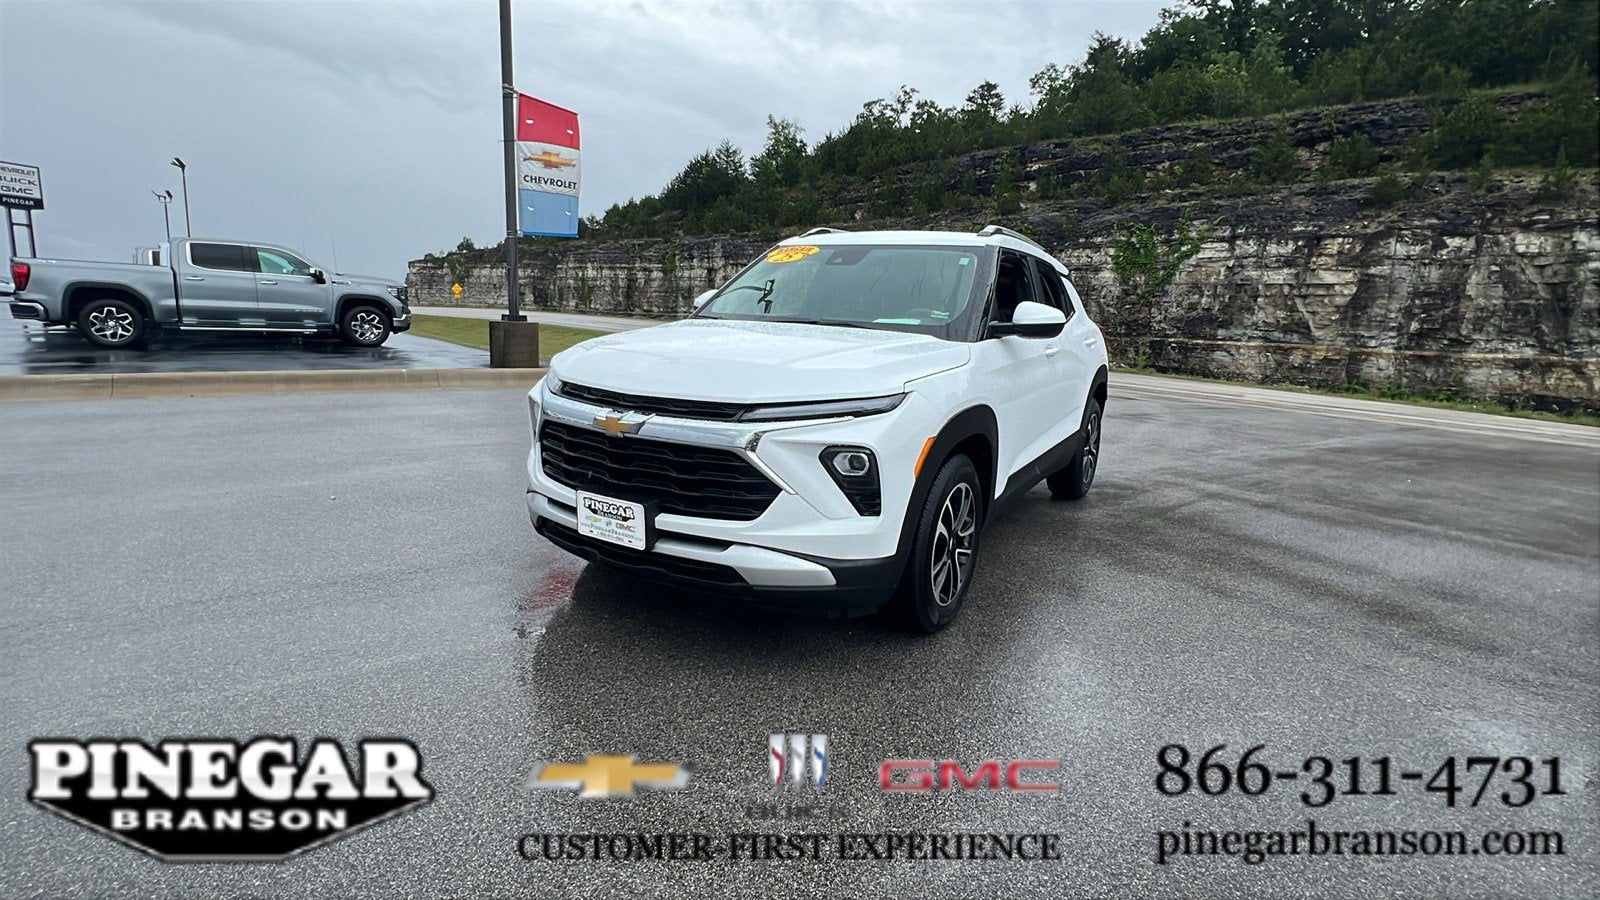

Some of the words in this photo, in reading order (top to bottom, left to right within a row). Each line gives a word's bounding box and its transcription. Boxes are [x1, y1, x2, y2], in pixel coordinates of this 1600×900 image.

[523, 174, 578, 190] CHEVROLET
[0, 185, 34, 196] GMC
[2, 196, 35, 206] PINEGAR
[583, 497, 635, 519] PINEGAR
[616, 523, 636, 533] GMC
